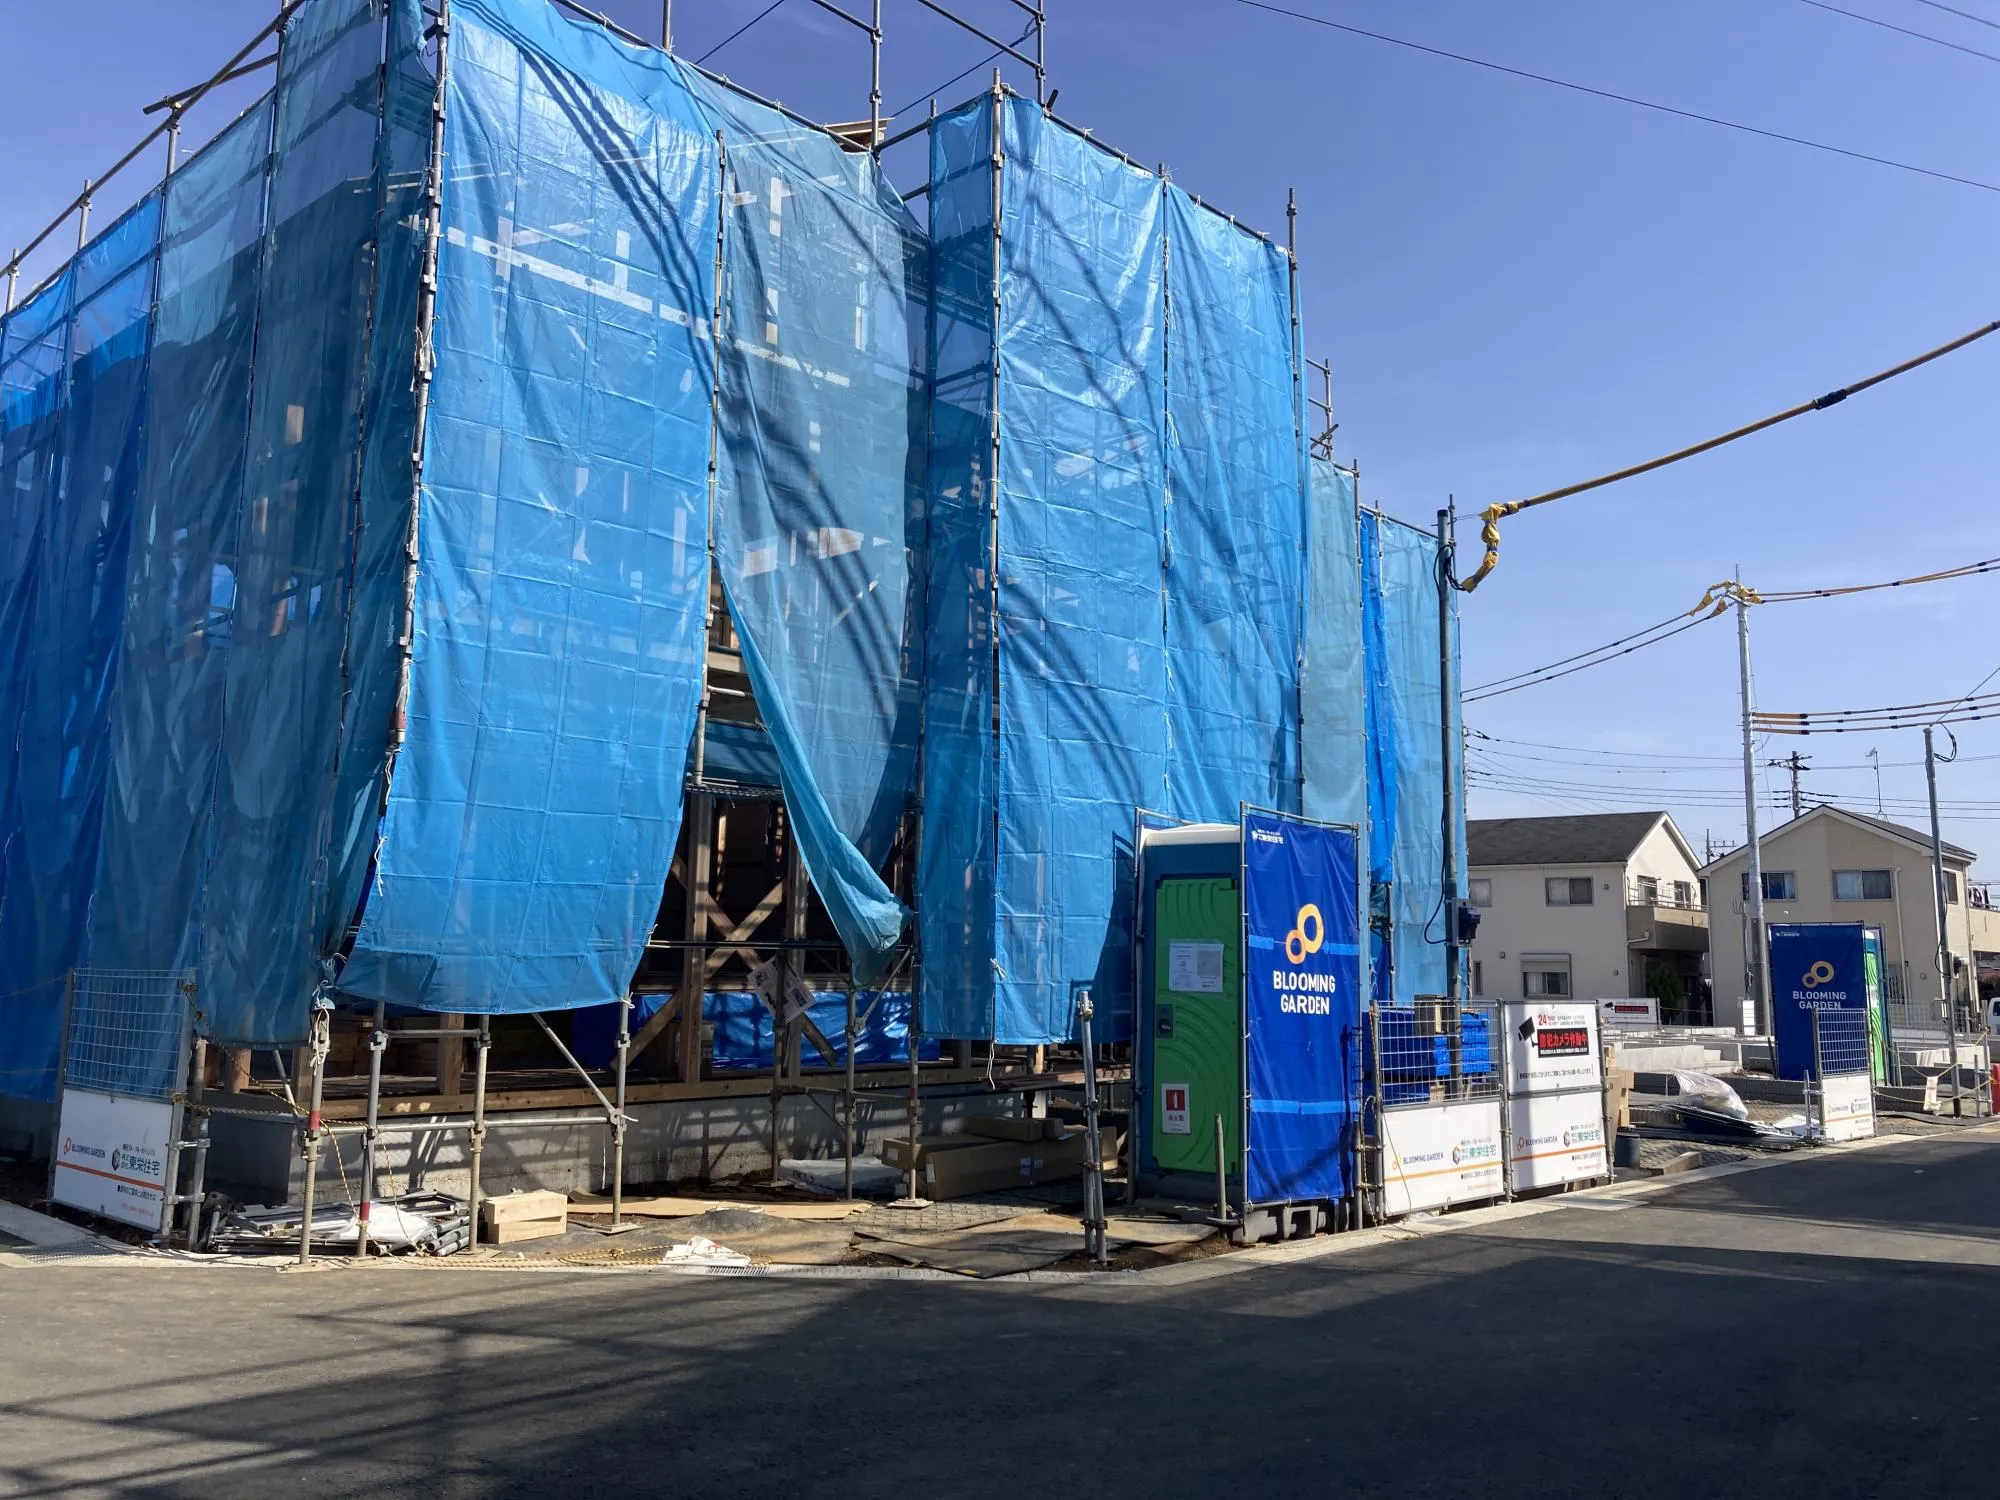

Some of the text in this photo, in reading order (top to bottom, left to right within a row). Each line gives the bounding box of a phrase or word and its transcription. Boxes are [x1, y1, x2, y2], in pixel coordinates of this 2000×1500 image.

[1273, 970, 1336, 993] BLOOMING
[1792, 990, 1847, 1000] BLOOMING
[1280, 994, 1330, 1015] GARDEN
[1799, 1000, 1841, 1010] GARDEN
[1538, 1014, 1547, 1026] 24
[1403, 1152, 1444, 1165] BLOOMING GARDEN
[128, 1155, 160, 1176] 東栄住宅
